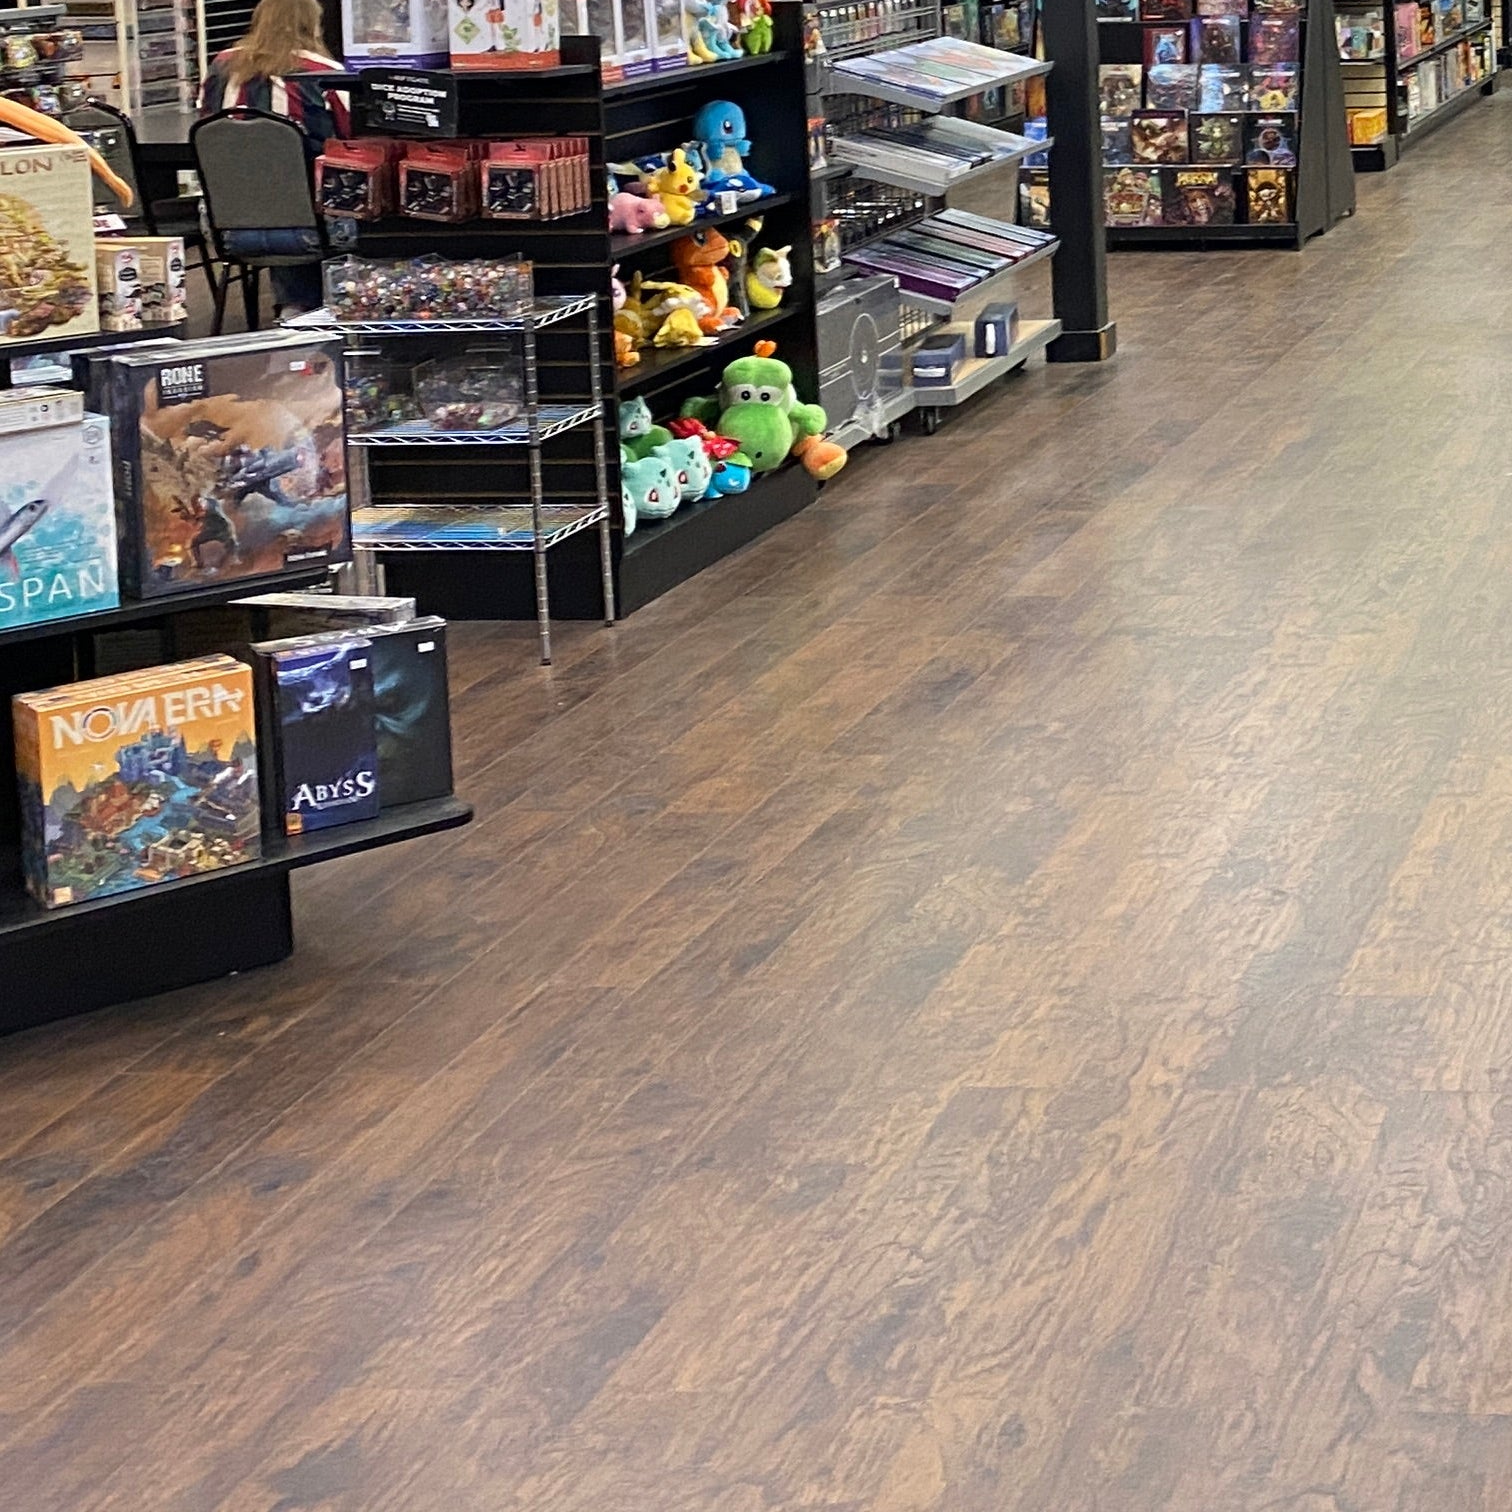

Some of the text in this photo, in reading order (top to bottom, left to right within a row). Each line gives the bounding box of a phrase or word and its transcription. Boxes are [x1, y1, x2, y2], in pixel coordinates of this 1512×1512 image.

[0, 157, 52, 175] LON
[0, 567, 105, 612] SPAN
[49, 683, 245, 749] NOVA ERA
